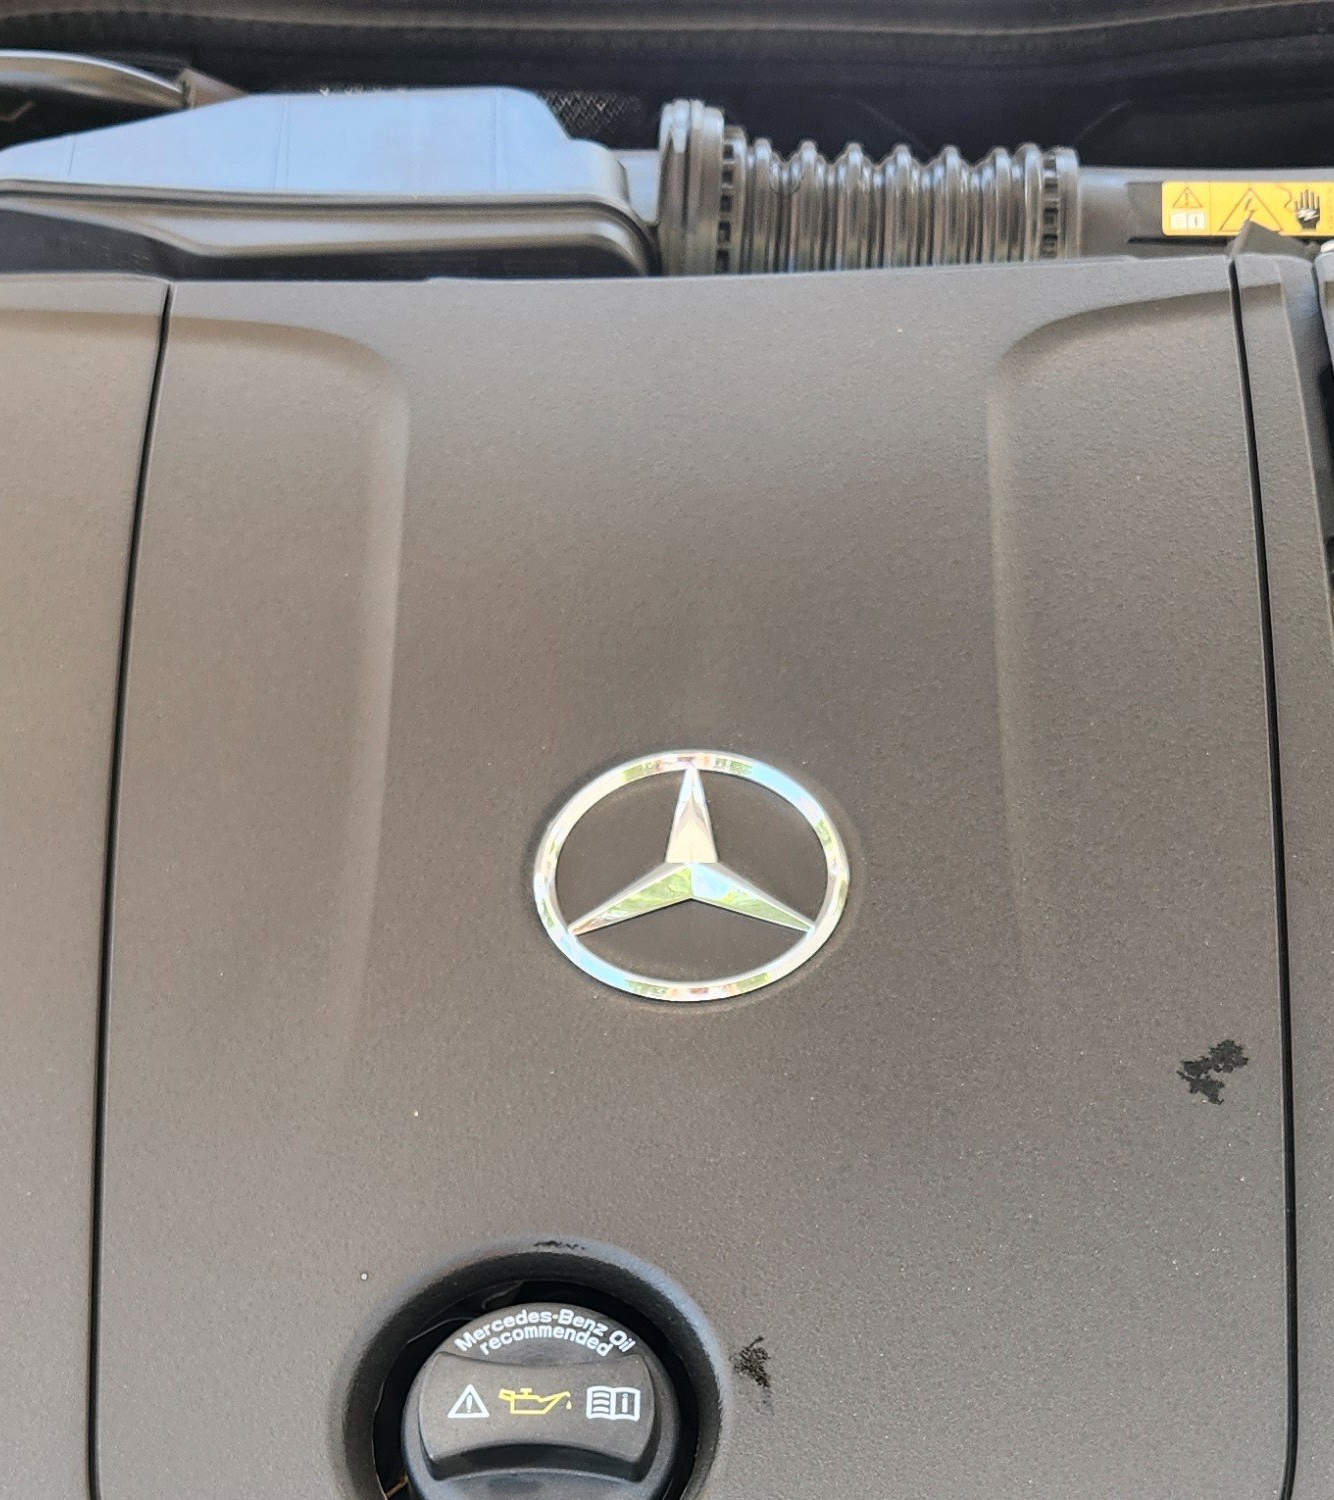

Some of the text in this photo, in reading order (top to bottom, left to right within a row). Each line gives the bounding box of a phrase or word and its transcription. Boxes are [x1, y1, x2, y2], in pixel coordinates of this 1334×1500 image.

[454, 1308, 636, 1353] Mercedes-Benz Oil
[479, 1325, 614, 1357] recommended
